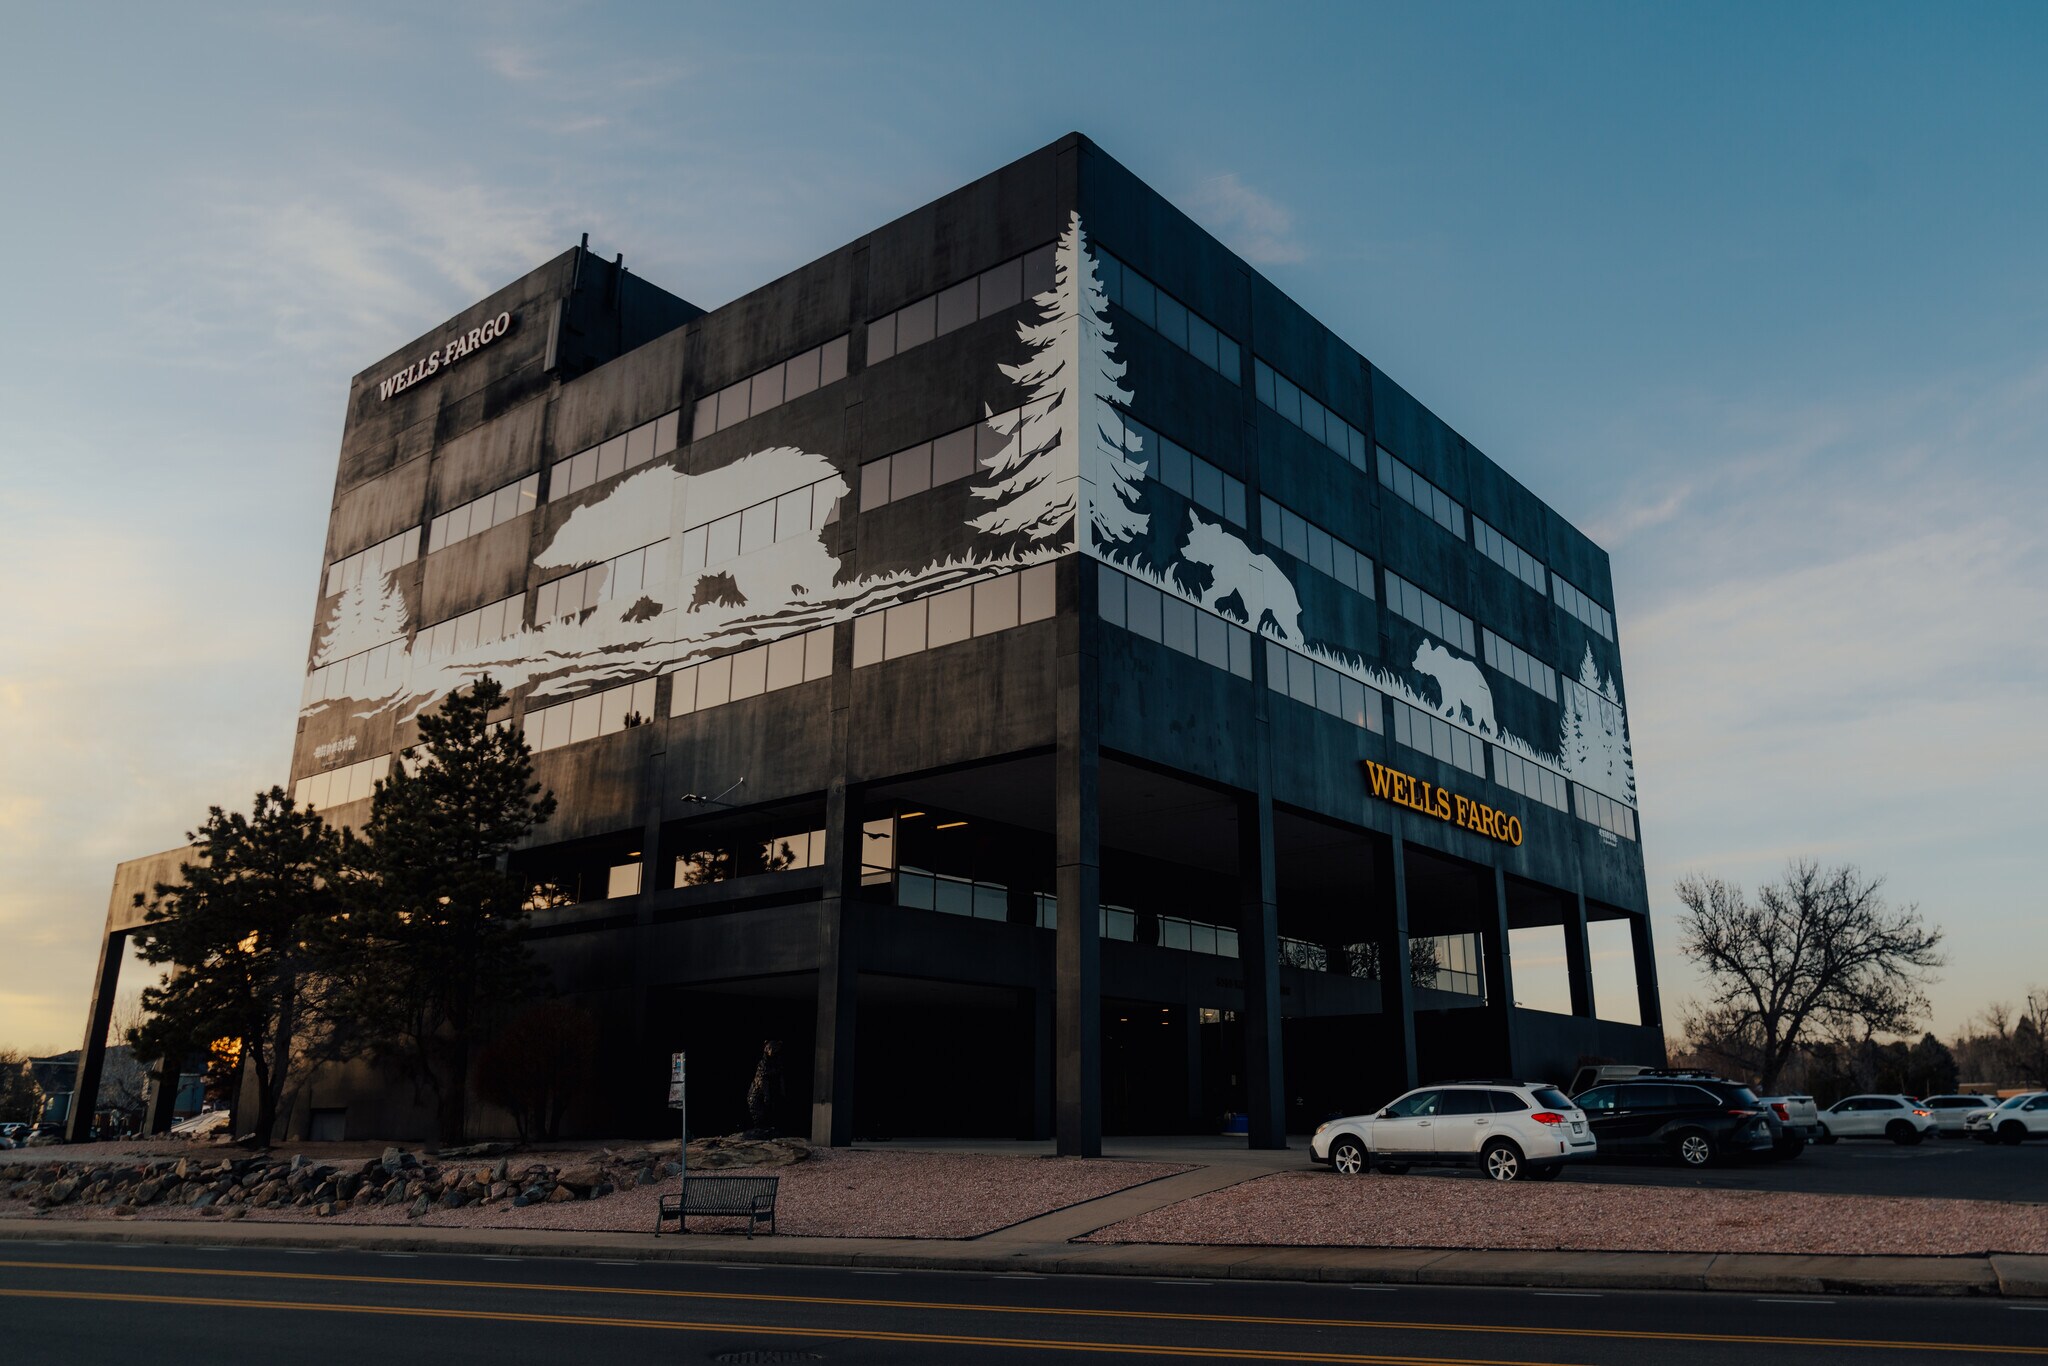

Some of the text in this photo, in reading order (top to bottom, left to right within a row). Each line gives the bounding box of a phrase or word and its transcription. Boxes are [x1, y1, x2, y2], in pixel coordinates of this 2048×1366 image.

[379, 311, 511, 402] WELLS FARGO
[1365, 759, 1524, 847] WELLS FARGO
